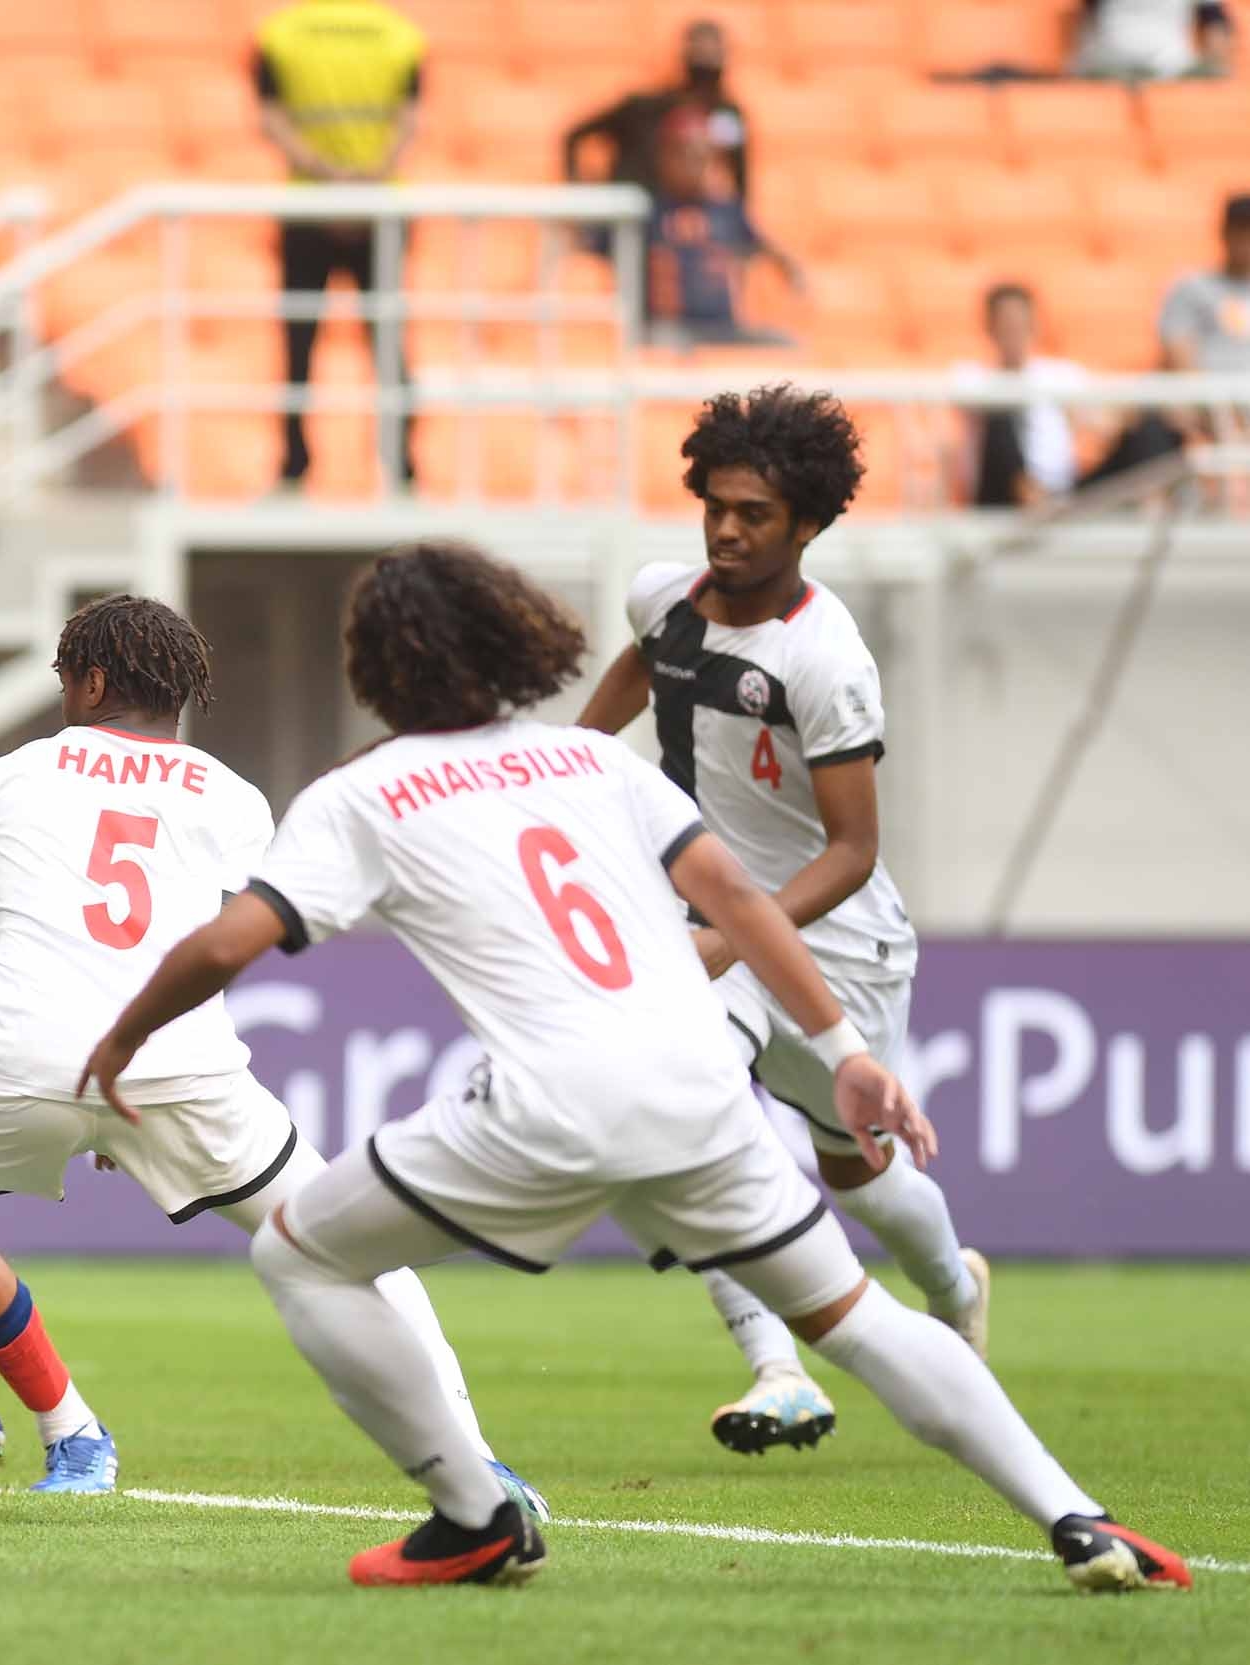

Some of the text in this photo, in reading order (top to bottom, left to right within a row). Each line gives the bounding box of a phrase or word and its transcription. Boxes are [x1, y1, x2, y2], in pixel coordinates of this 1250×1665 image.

[58, 745, 208, 795] HANYE
[379, 744, 604, 820] HNAISSILIN
[752, 727, 782, 790] 4
[82, 809, 158, 950] 5
[518, 826, 633, 991] 6
